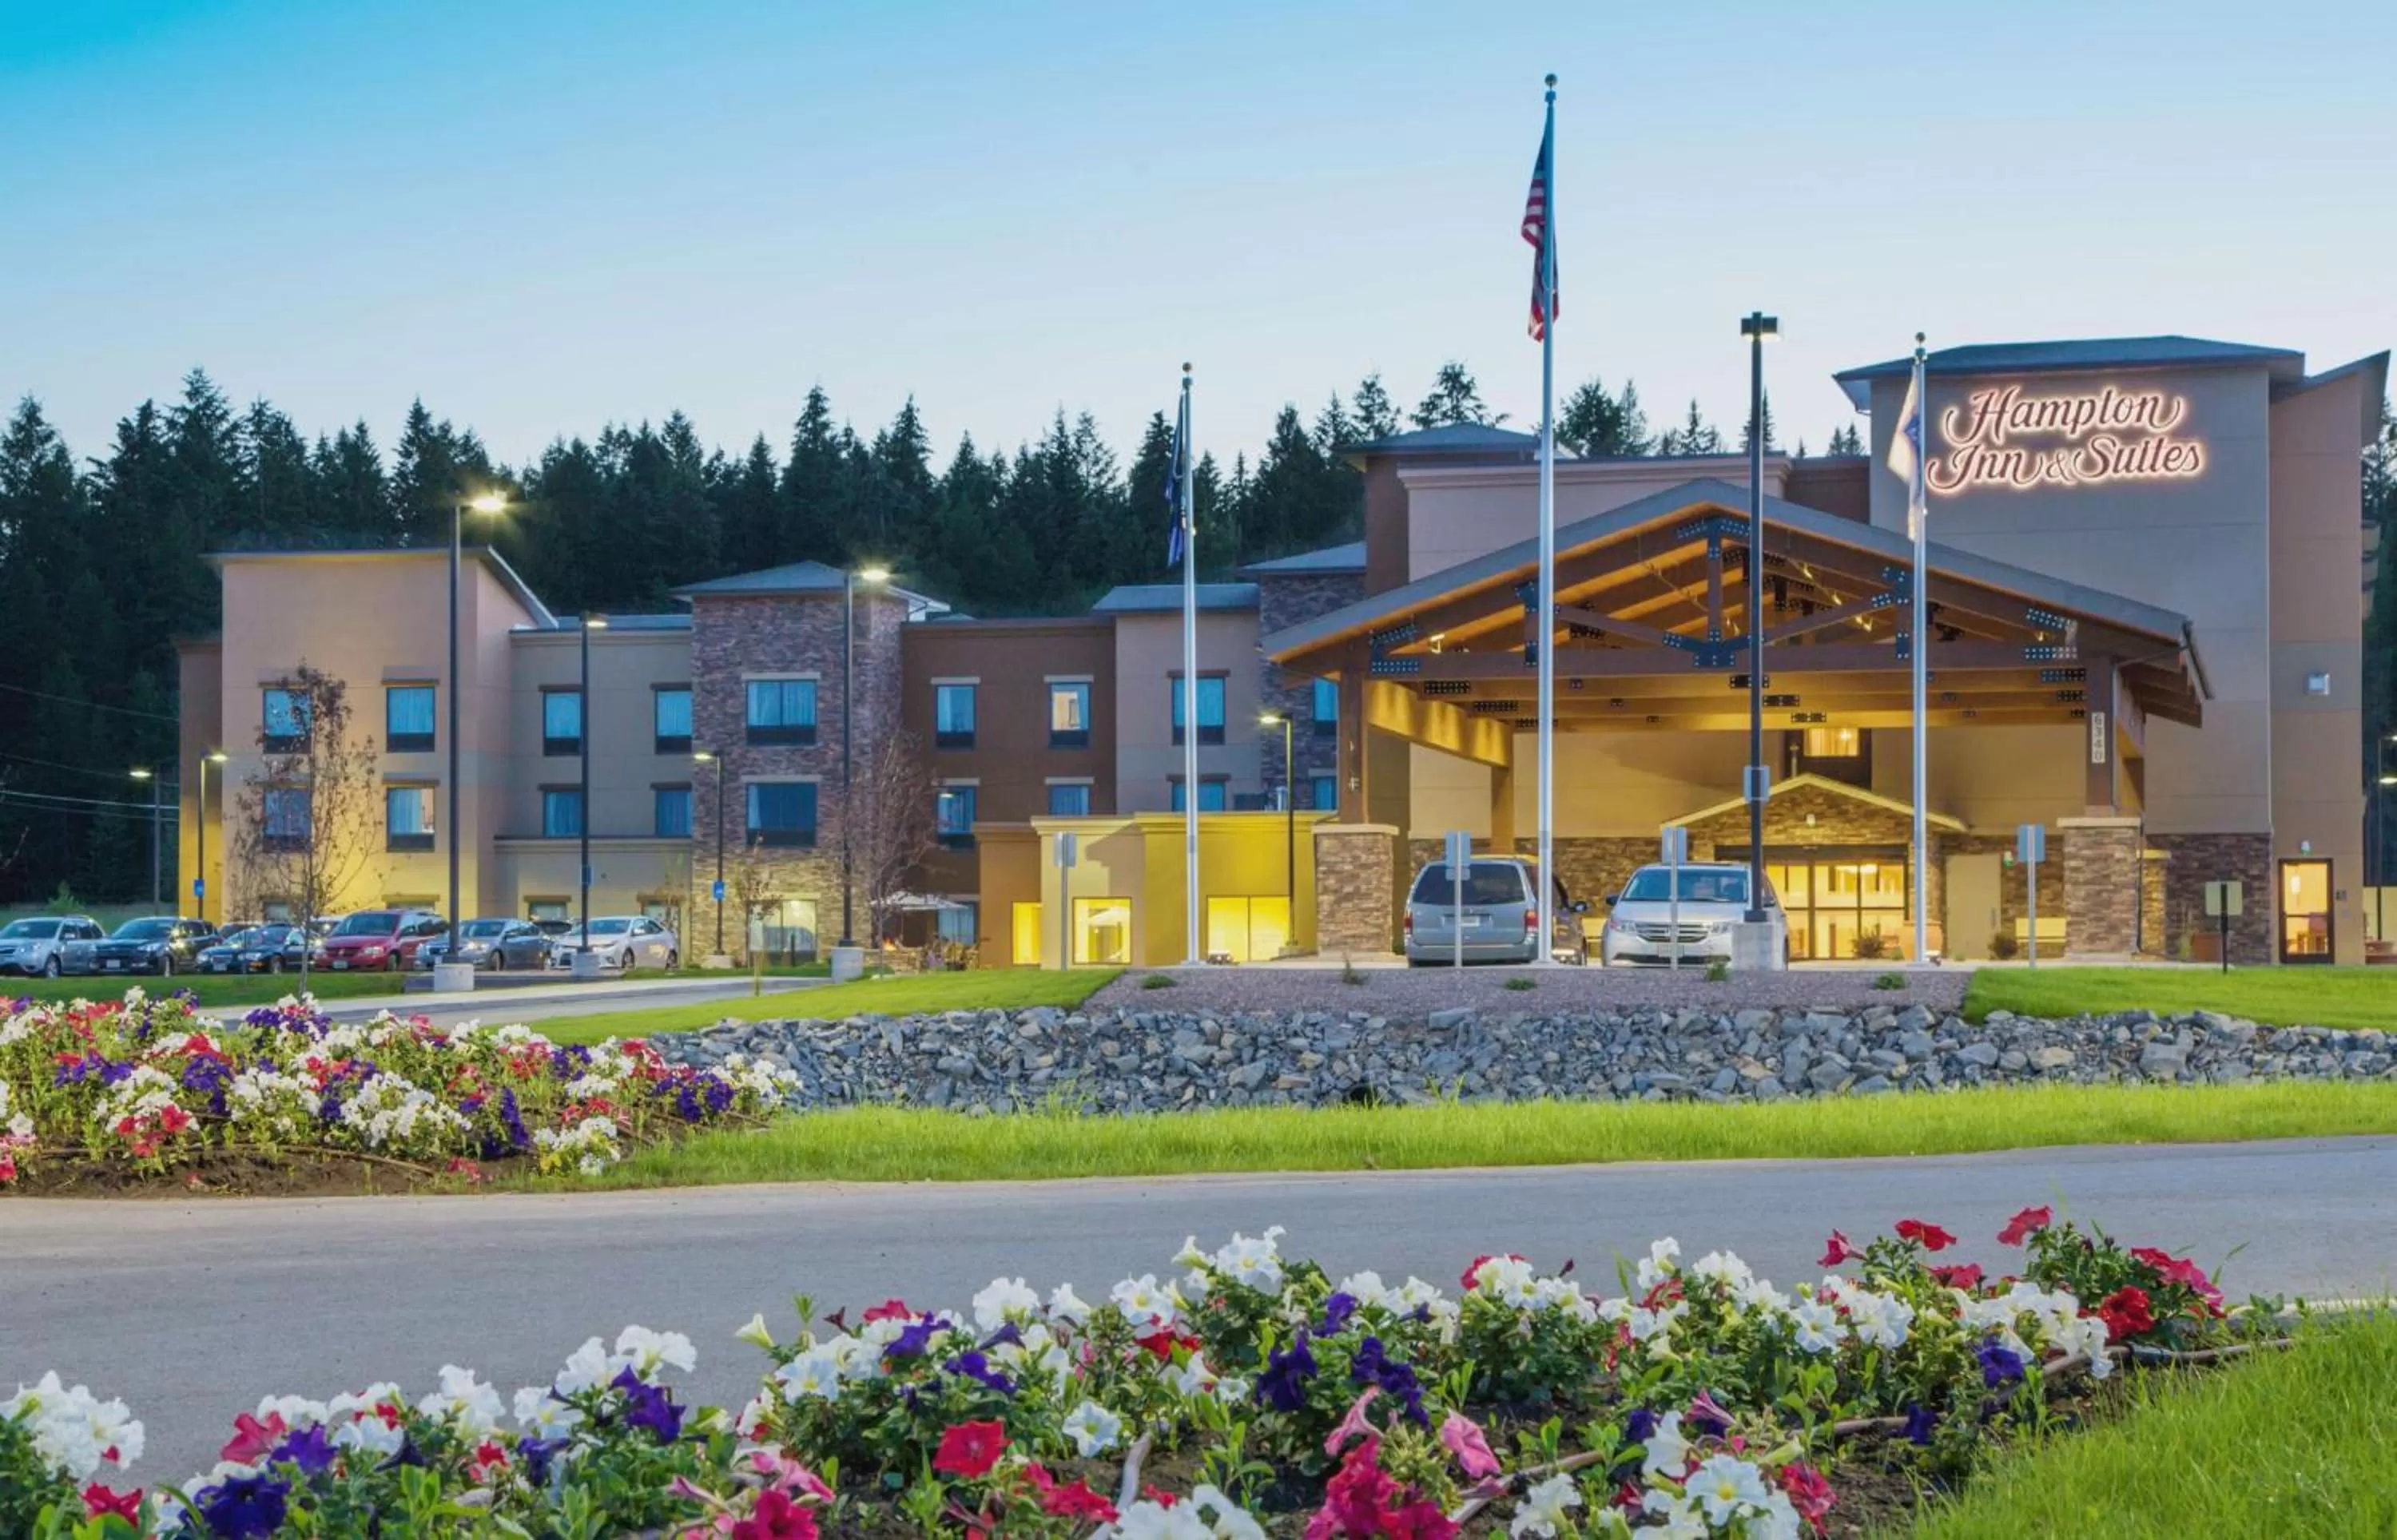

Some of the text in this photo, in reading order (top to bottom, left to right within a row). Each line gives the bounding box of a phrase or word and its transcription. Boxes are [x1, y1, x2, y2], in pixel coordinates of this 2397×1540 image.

[1945, 387, 2184, 445] Hampton
[1927, 435, 2202, 490] Inn & Suites
